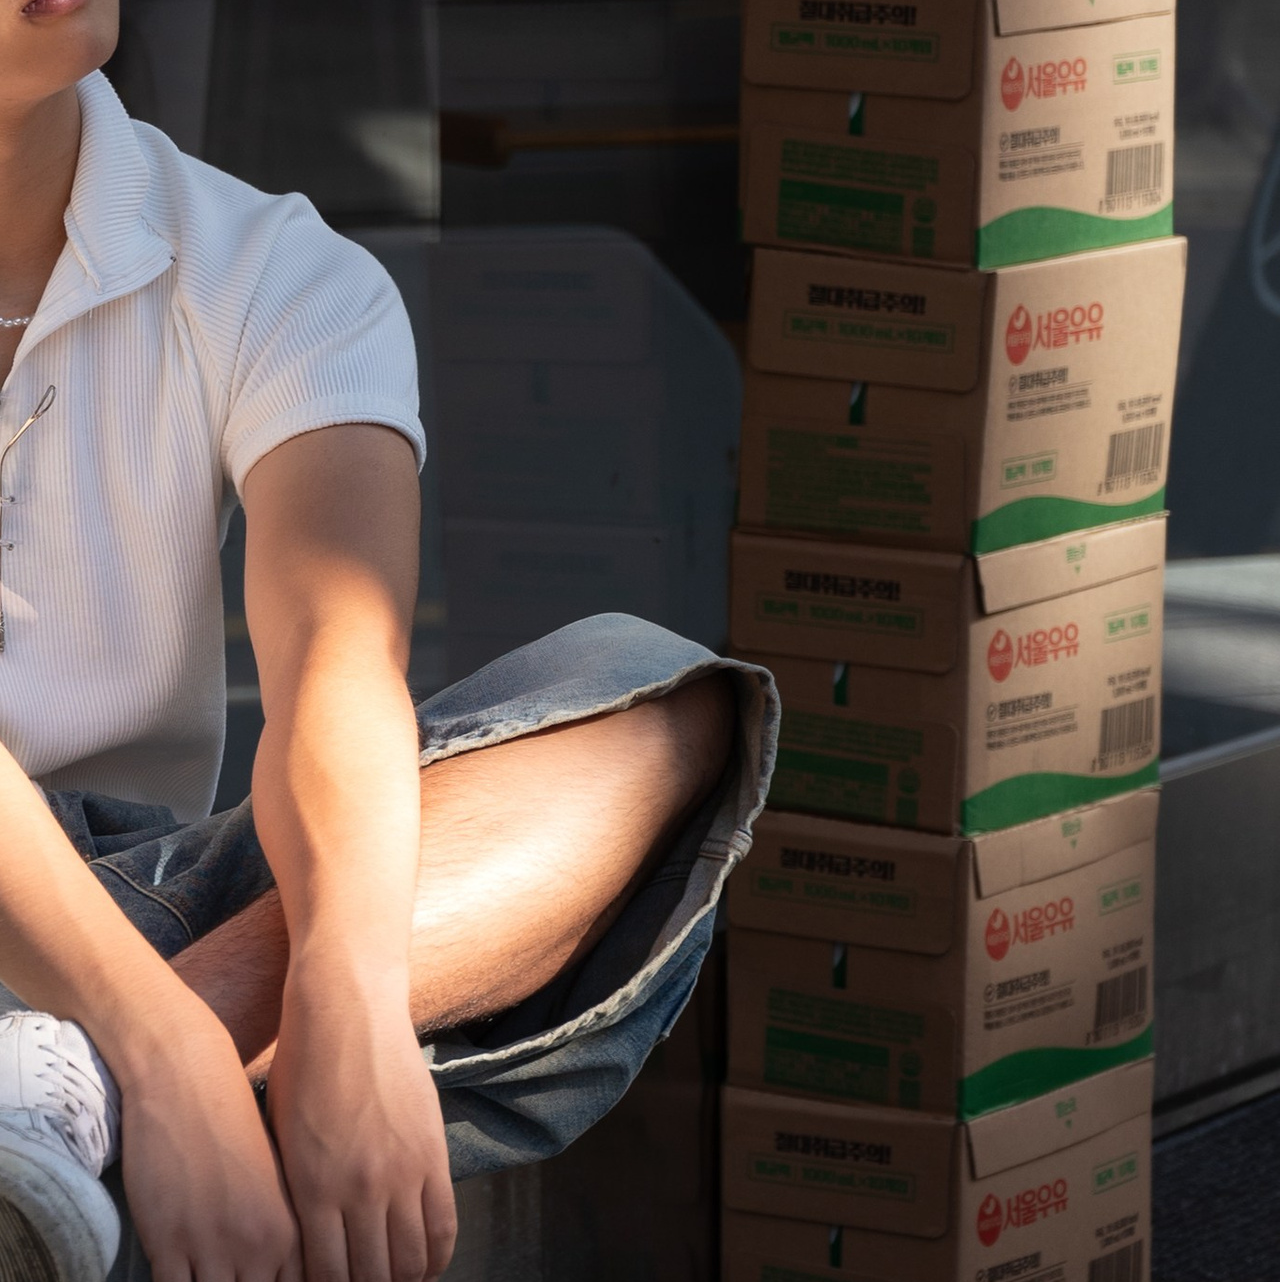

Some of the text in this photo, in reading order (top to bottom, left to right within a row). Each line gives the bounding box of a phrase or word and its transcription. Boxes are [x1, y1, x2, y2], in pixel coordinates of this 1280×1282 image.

[799, 0, 917, 26] 절대취급주의!
[1026, 57, 1087, 99] 서울우유
[1033, 302, 1104, 350] 서울우유
[1015, 622, 1079, 668] 서울우유
[1012, 896, 1074, 944] 서울우유
[1004, 1178, 1069, 1229] 서울우유
